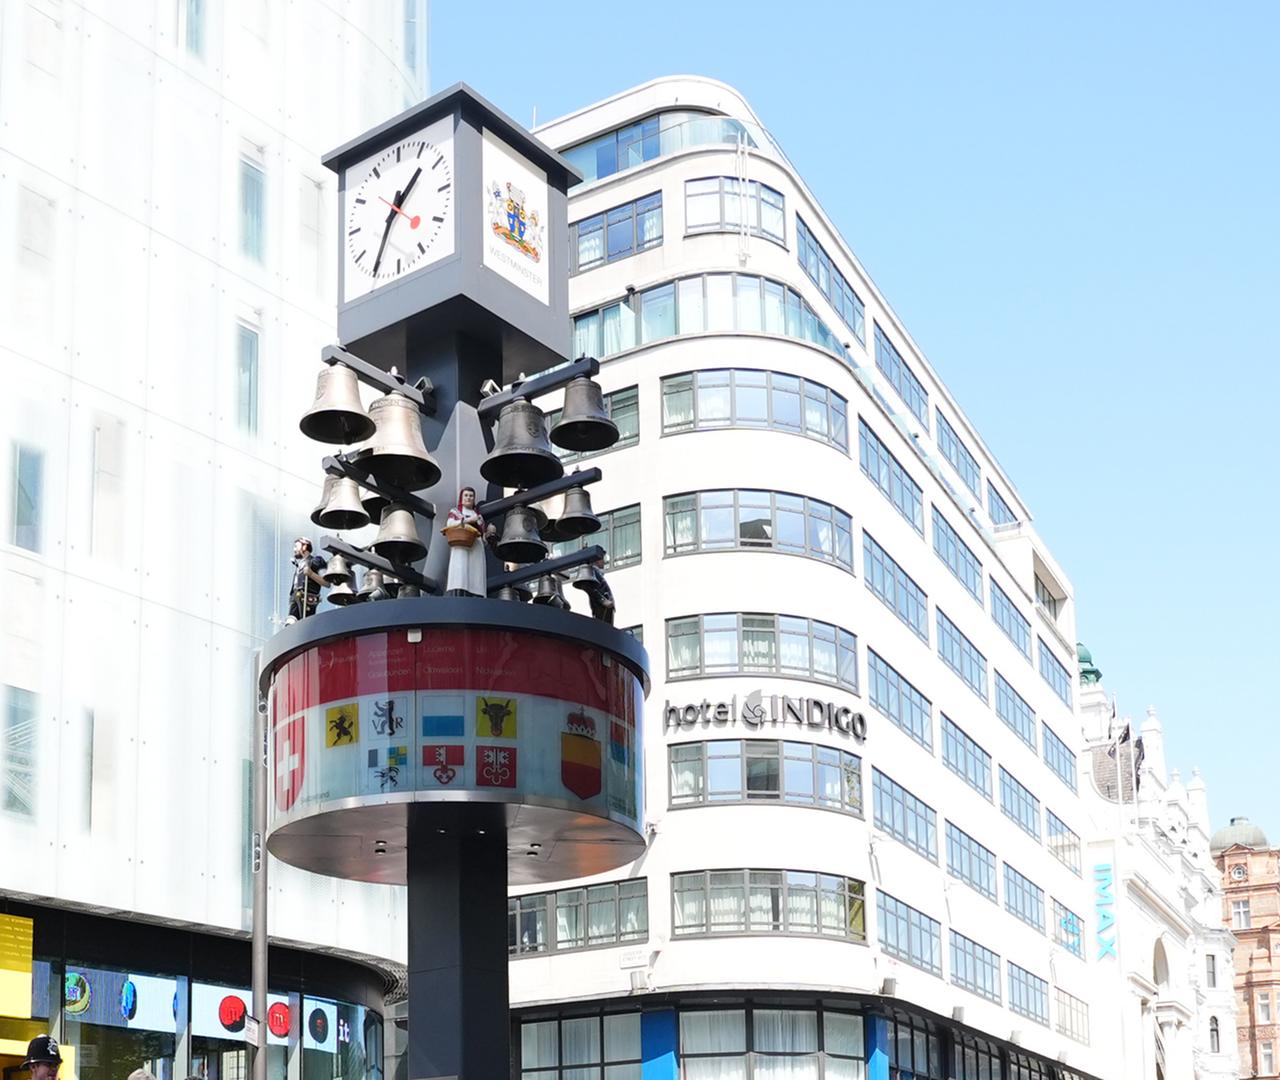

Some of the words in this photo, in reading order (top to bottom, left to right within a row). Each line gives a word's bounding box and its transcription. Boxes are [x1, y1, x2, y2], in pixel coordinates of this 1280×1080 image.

[663, 694, 737, 732] hotel
[771, 694, 867, 741] INDIGO
[1094, 863, 1118, 961] IMAX
[338, 1018, 350, 1042] it
